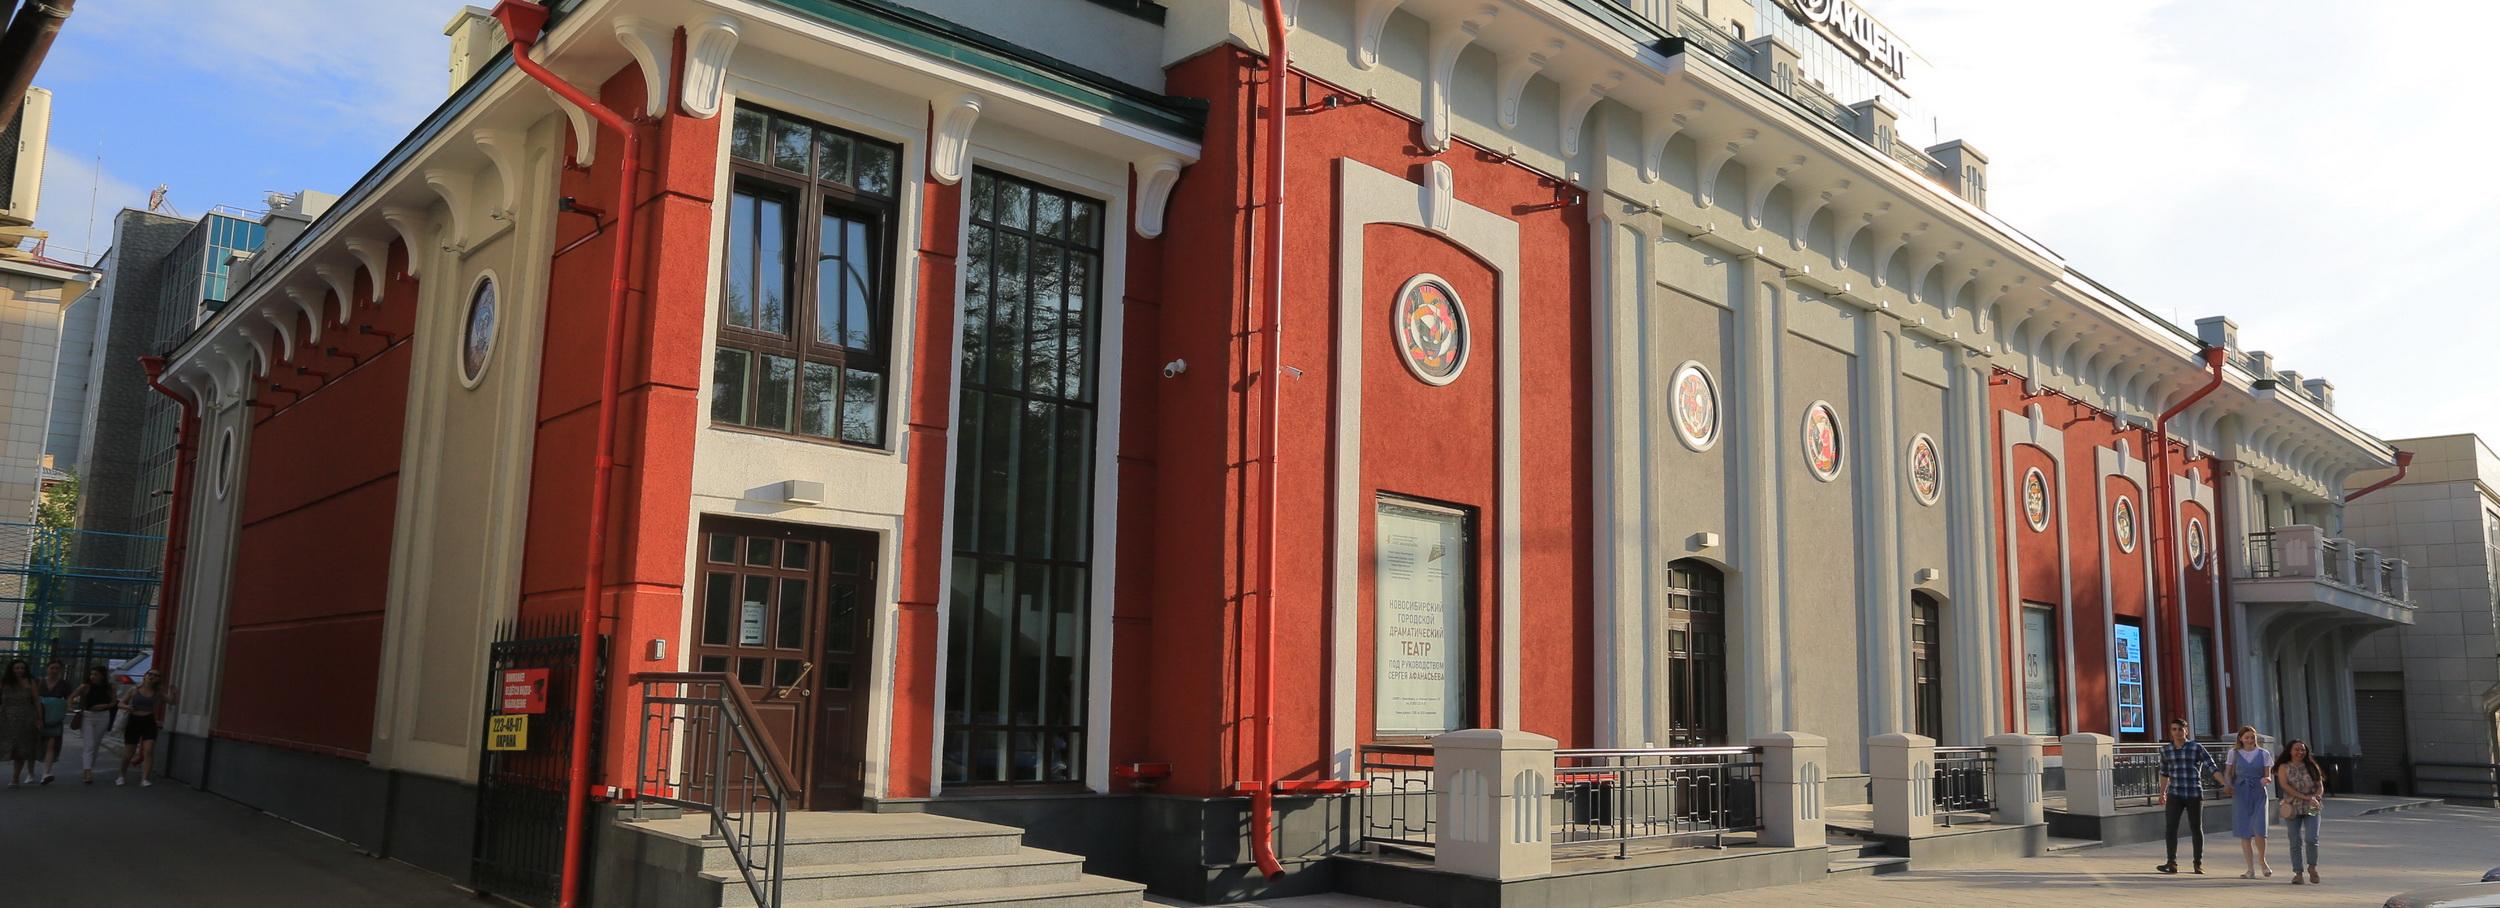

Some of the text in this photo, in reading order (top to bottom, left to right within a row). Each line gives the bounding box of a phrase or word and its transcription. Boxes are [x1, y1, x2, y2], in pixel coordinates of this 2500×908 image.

[1389, 600, 1444, 613] НОВОСИБИРСКИЙ
[1398, 613, 1435, 625] ГОРОДСКОЙ
[1389, 626, 1444, 638] ДРАМАТИЧЕСКИЙ
[1401, 641, 1431, 656] ТЕАТР
[1388, 660, 1444, 670] ПОД РУКОВОДСТВОМ
[2027, 653, 2038, 677] 35
[1388, 671, 1444, 681] СЕРГЕЯ АФАНАСЬЕВА
[496, 734, 516, 748] ОХРАНА
